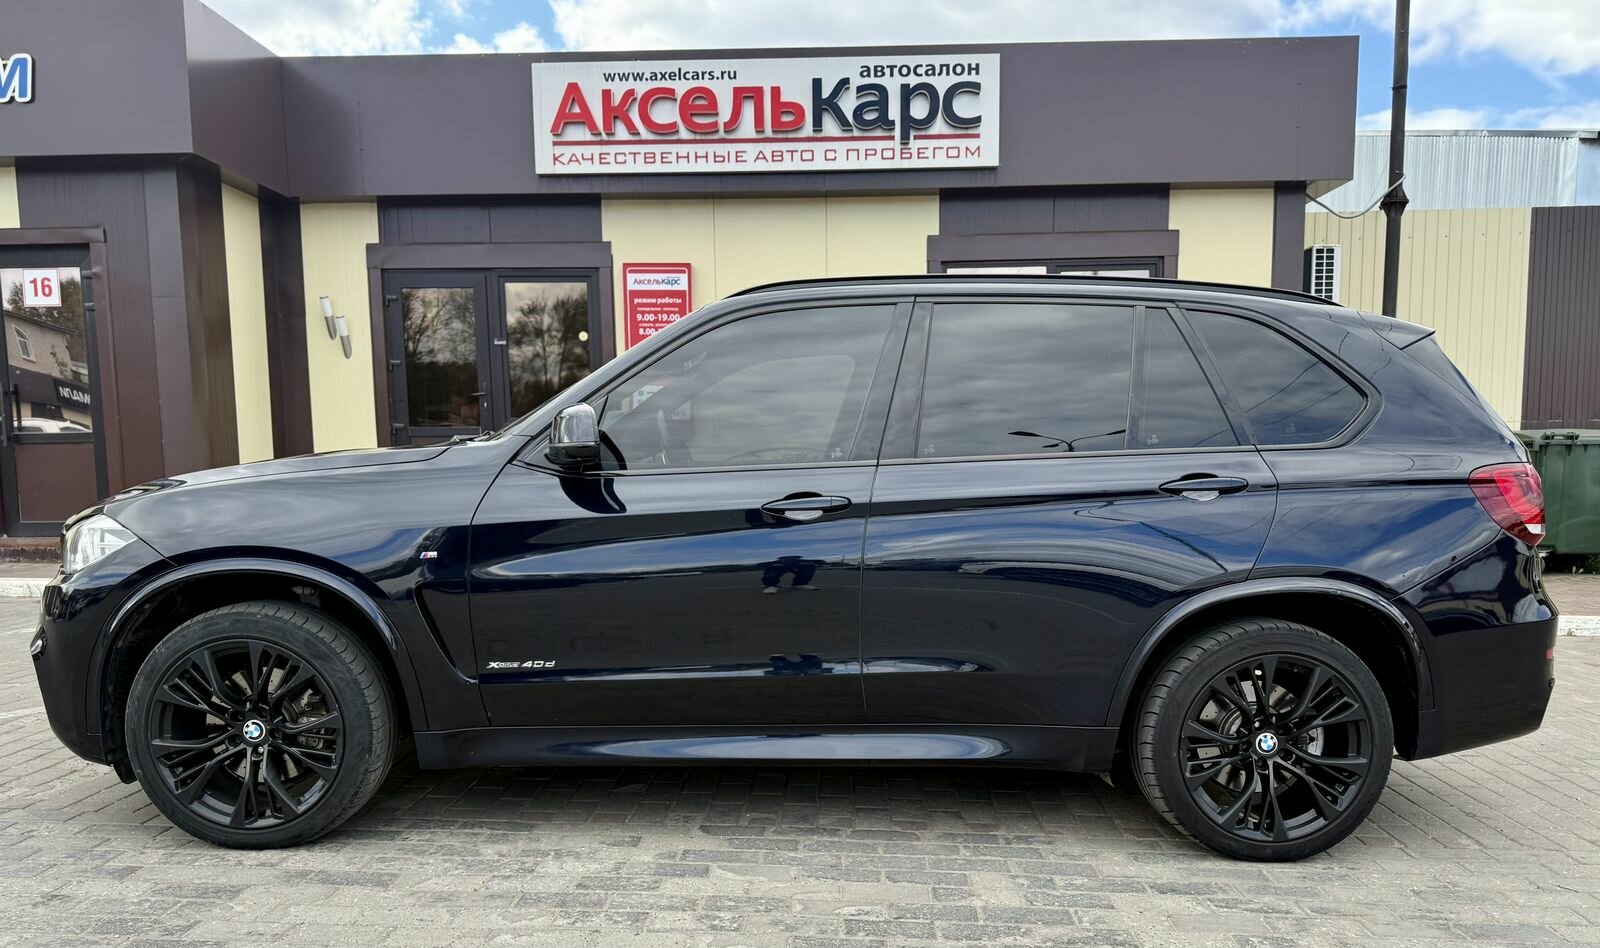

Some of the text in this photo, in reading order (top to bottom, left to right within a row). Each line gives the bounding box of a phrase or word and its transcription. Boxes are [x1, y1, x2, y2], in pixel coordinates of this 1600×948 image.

[603, 67, 737, 82] www.axelcars.ru
[859, 62, 980, 78] автосалон
[550, 77, 982, 145] АксельКарс
[553, 145, 980, 165] КАЧЕСТВЕННЫЕ АВТО С ПРОБЕГОМ
[29, 277, 53, 297] 16
[636, 313, 680, 321] 9.00-19.00
